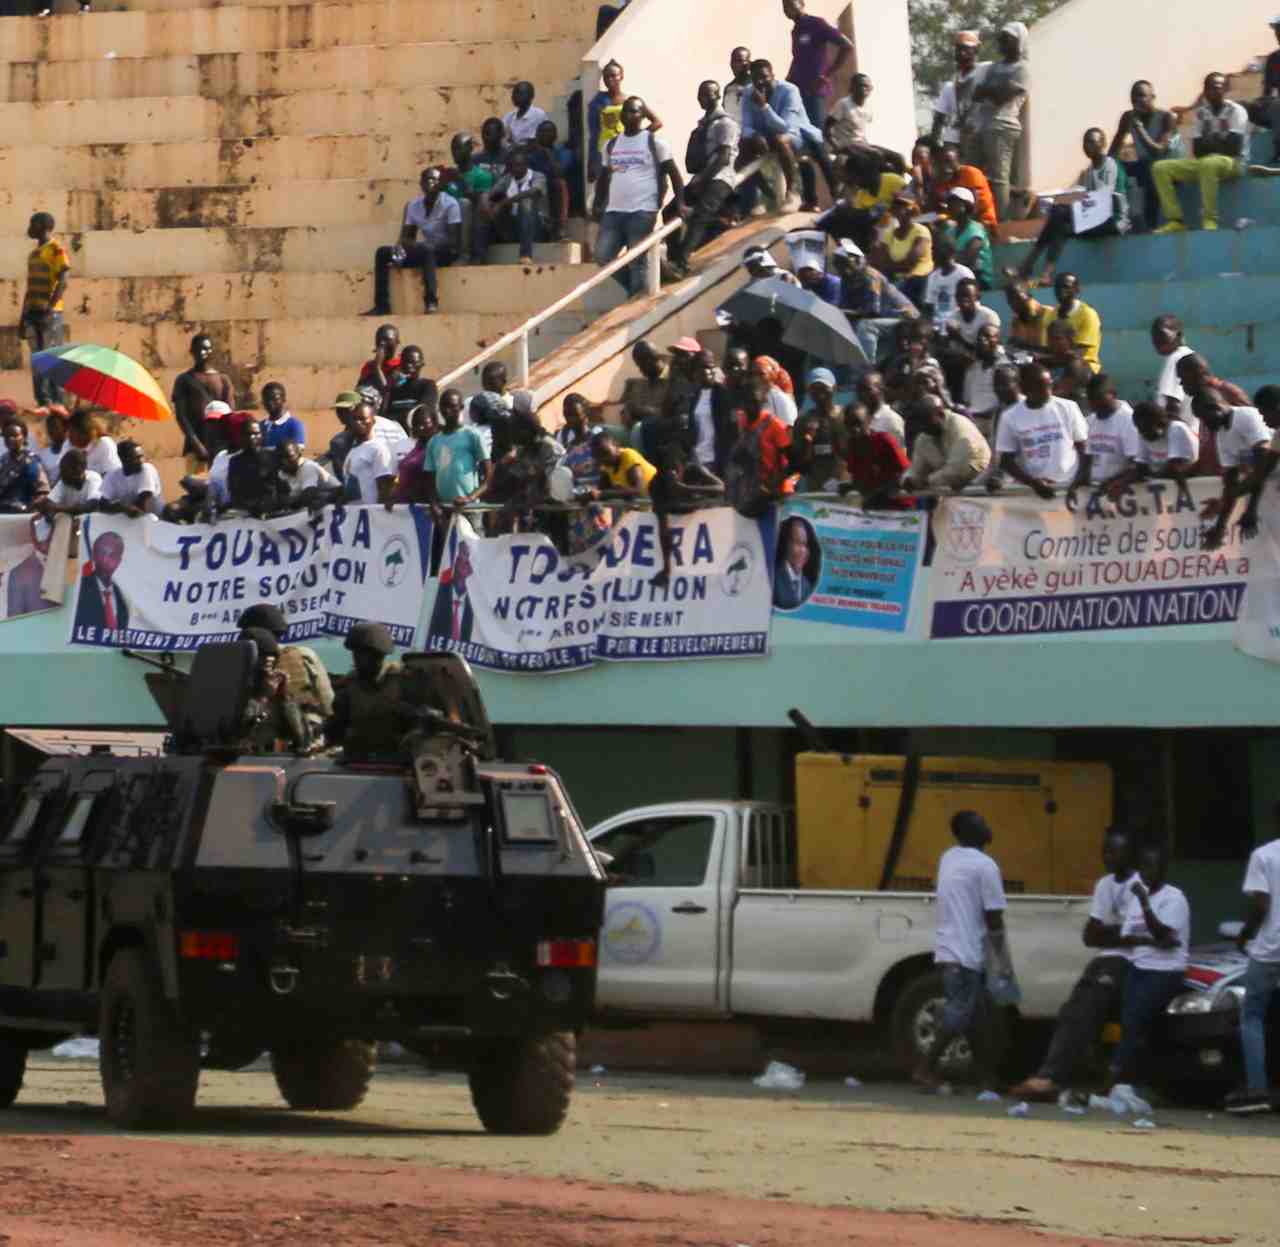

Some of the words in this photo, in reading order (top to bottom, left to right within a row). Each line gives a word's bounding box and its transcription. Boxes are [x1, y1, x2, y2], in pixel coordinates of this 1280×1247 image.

[1023, 524, 1112, 560] Comité
[1118, 521, 1148, 555] de
[163, 577, 246, 604] NOTRE
[959, 571, 976, 593] A
[1043, 564, 1084, 595] gui
[1090, 554, 1230, 586] TOUADERA
[962, 595, 1140, 635] COORDINATION
[77, 624, 97, 640] LE
[174, 635, 192, 648] DU
[641, 636, 658, 653] LE
